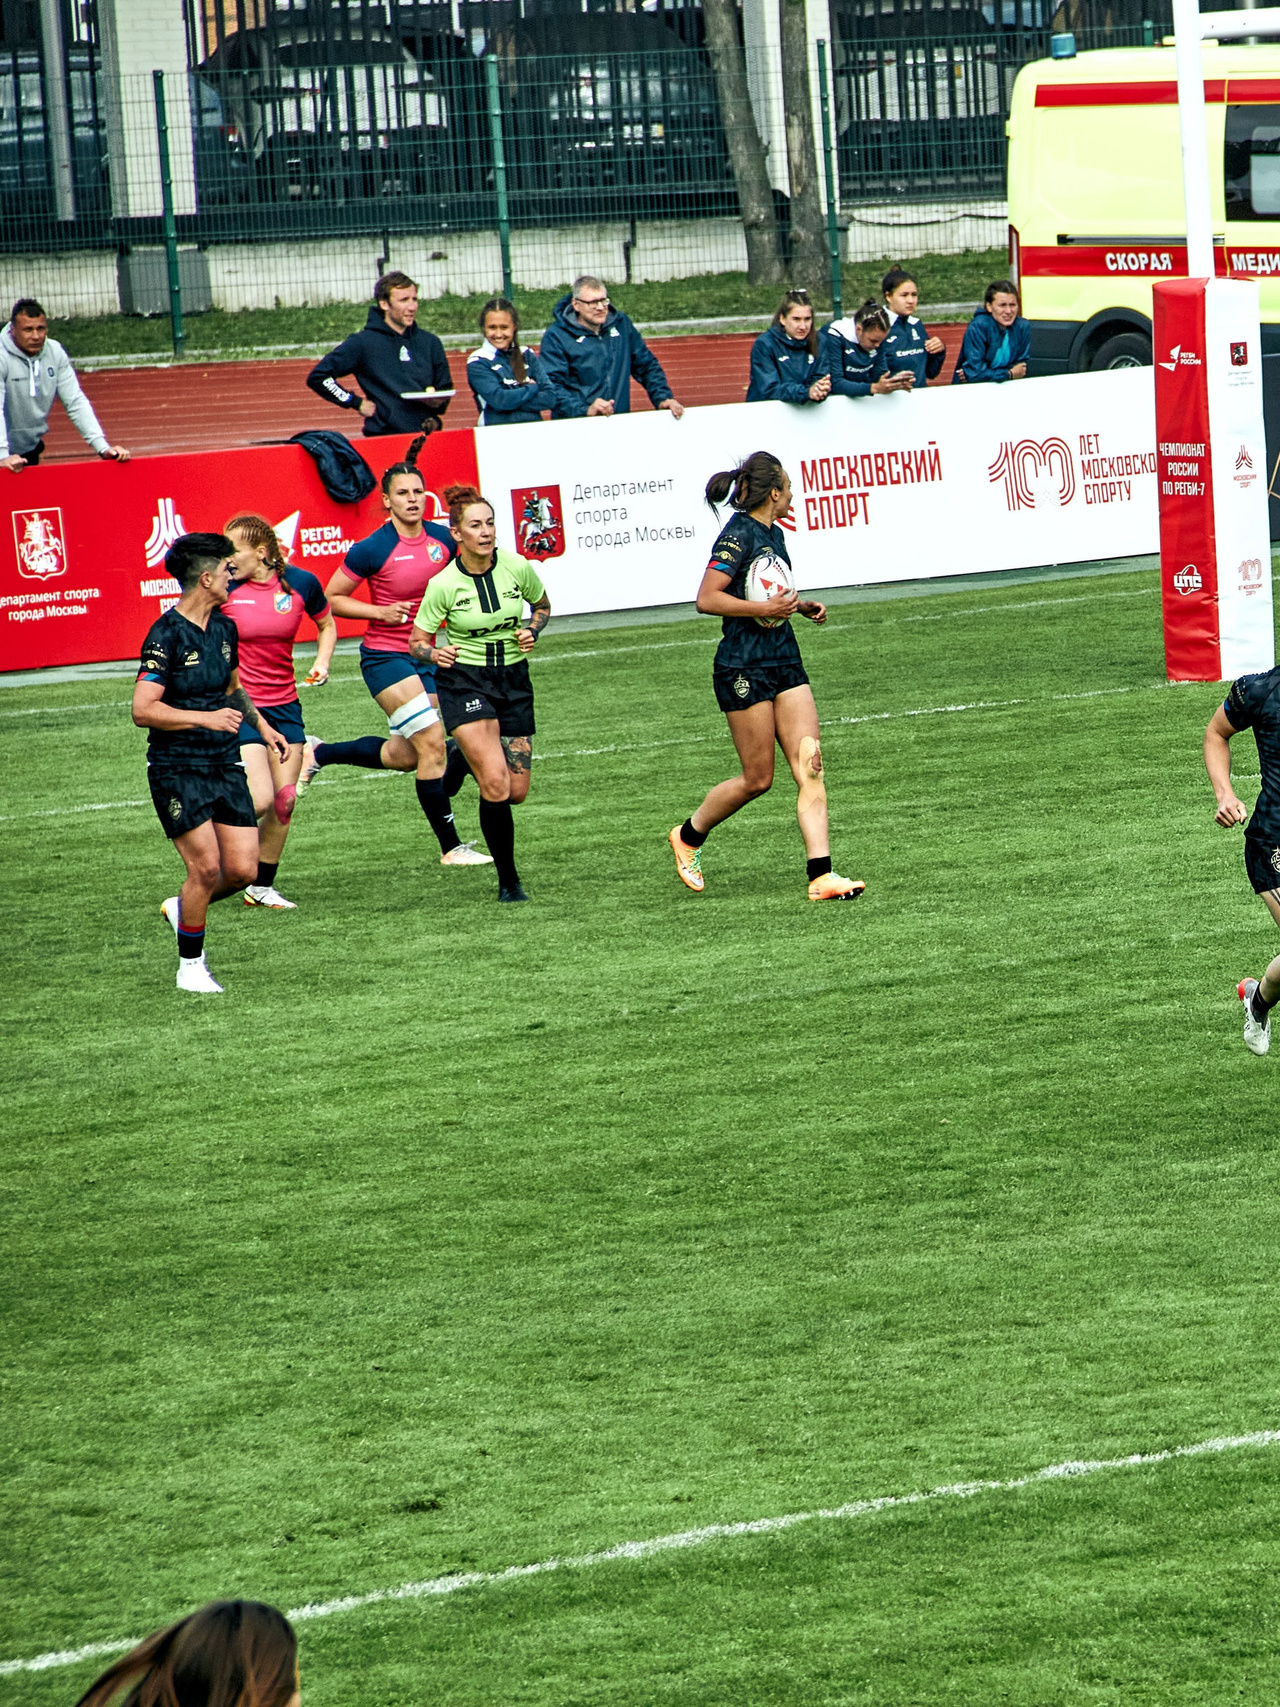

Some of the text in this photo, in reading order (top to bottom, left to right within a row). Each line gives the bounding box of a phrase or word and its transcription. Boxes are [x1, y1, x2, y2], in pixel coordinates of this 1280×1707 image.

[1105, 253, 1172, 270] СКОРАЯ
[1079, 433, 1100, 456] ЛЕТ
[1159, 442, 1206, 457] ЧЕМПИОНАТ
[800, 441, 943, 493] МОСКОВСКИЙ
[1081, 452, 1157, 480] МОСКОВСКО
[1168, 462, 1199, 477] РОССИИ
[573, 479, 675, 504] Департамент
[1084, 480, 1131, 504] СПОРТУ
[1162, 481, 1206, 496] ПО РЕГБИ-7
[575, 507, 628, 526] спорта
[805, 492, 870, 531] СПОРТ
[300, 526, 342, 542] РЕГБИ
[577, 526, 696, 551] города Москвы
[302, 540, 355, 558] РОССИИ
[64, 588, 100, 602] спорта
[140, 578, 183, 597] МОСКОВ
[8, 605, 87, 624] города Москвы
